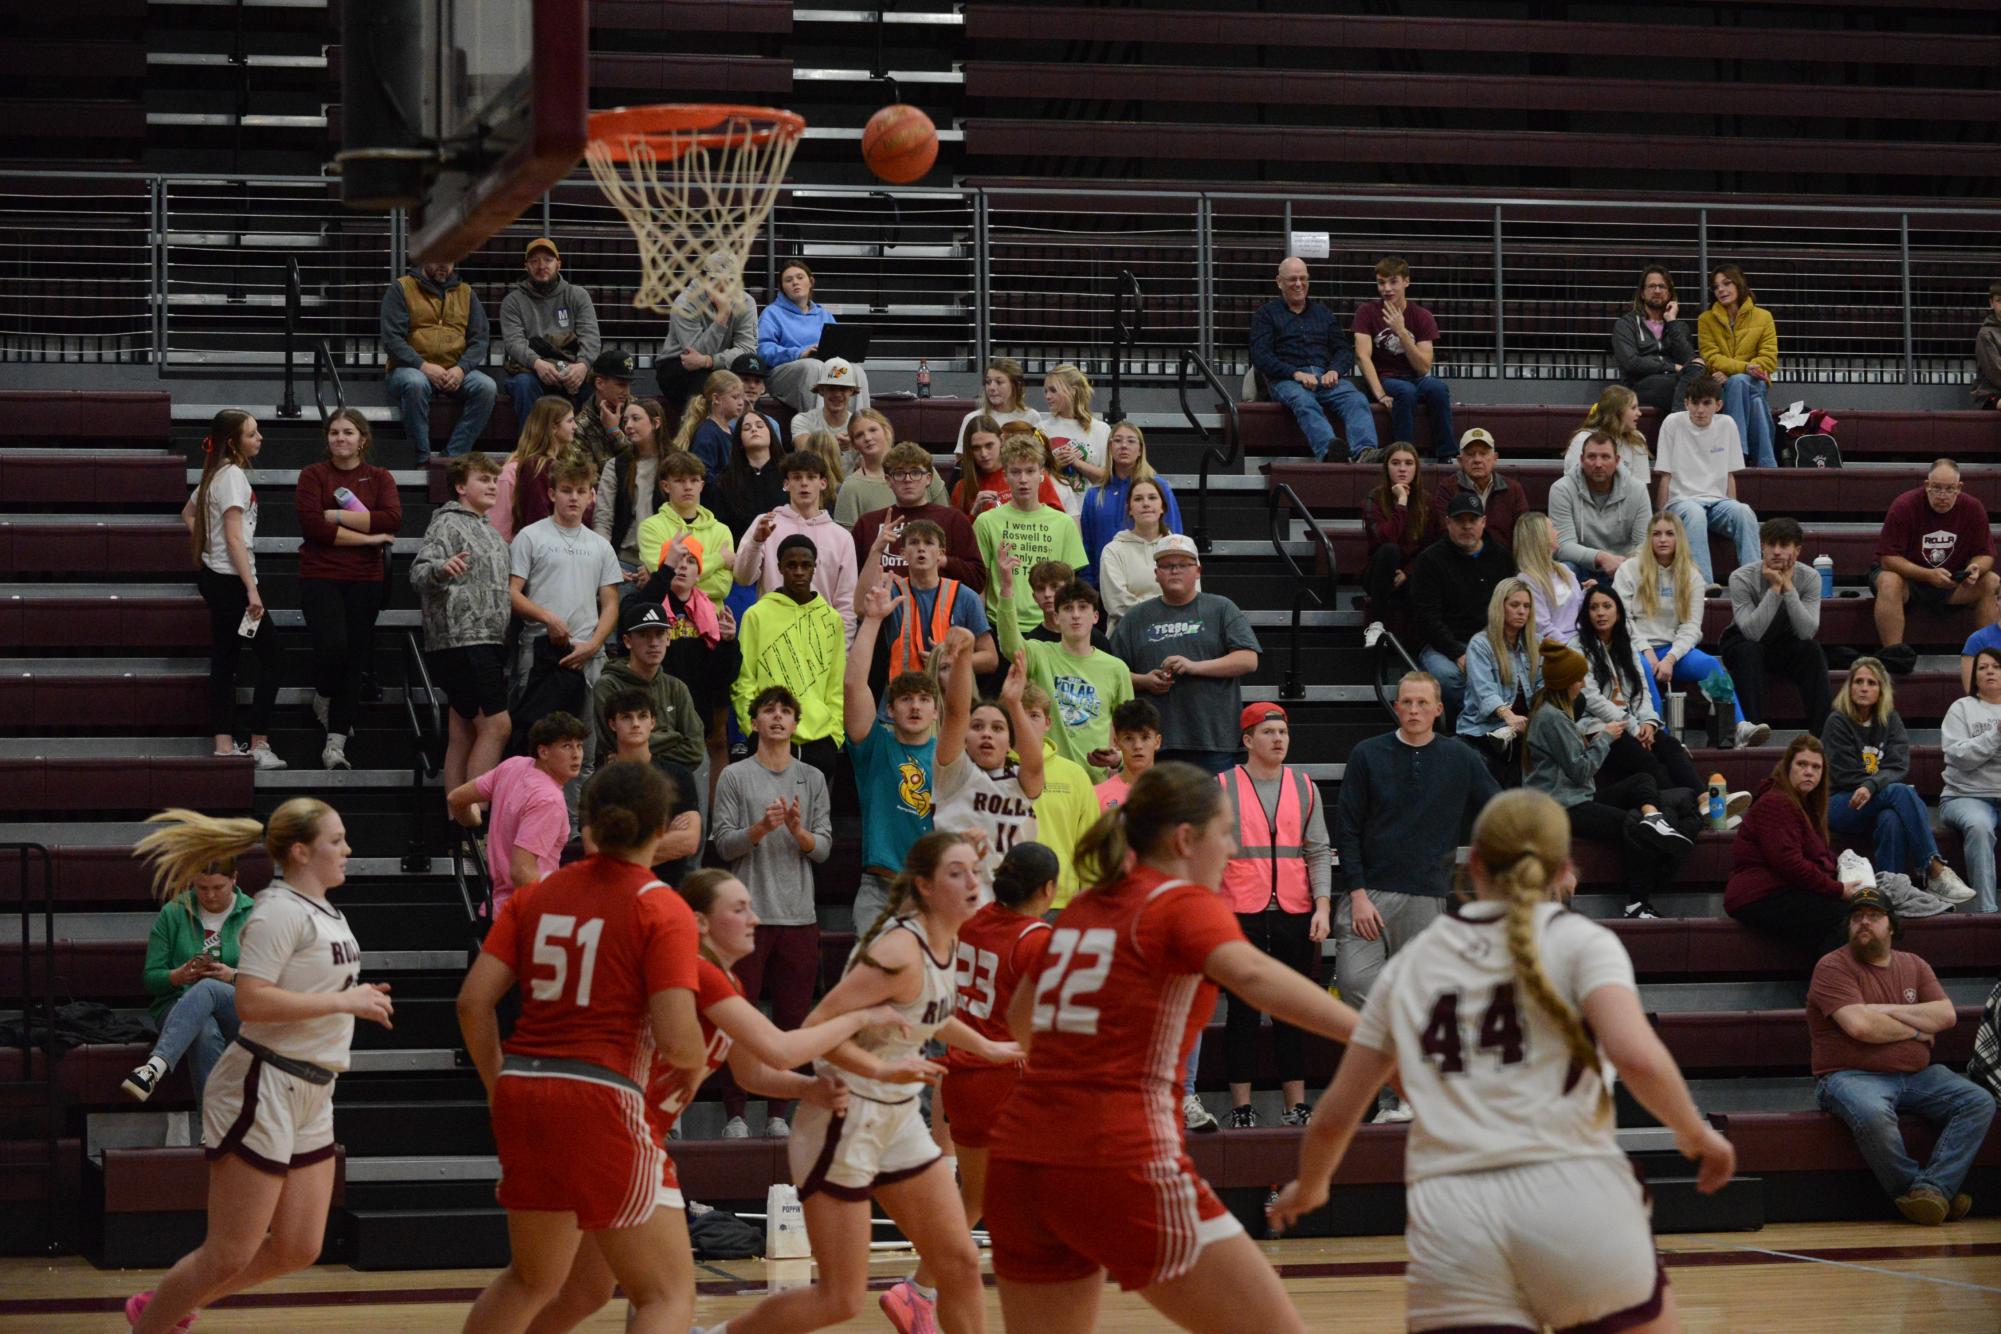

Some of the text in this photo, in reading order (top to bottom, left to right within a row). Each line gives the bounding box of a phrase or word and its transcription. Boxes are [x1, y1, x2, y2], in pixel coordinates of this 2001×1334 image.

[1002, 530, 1052, 543] Roswell to
[1005, 521, 1049, 532] I went to
[1924, 536, 1955, 544] ROLLA
[530, 912, 605, 1007] 51
[956, 940, 999, 1021] 23
[1031, 927, 1118, 1036] 22
[1423, 981, 1524, 1073] 44
